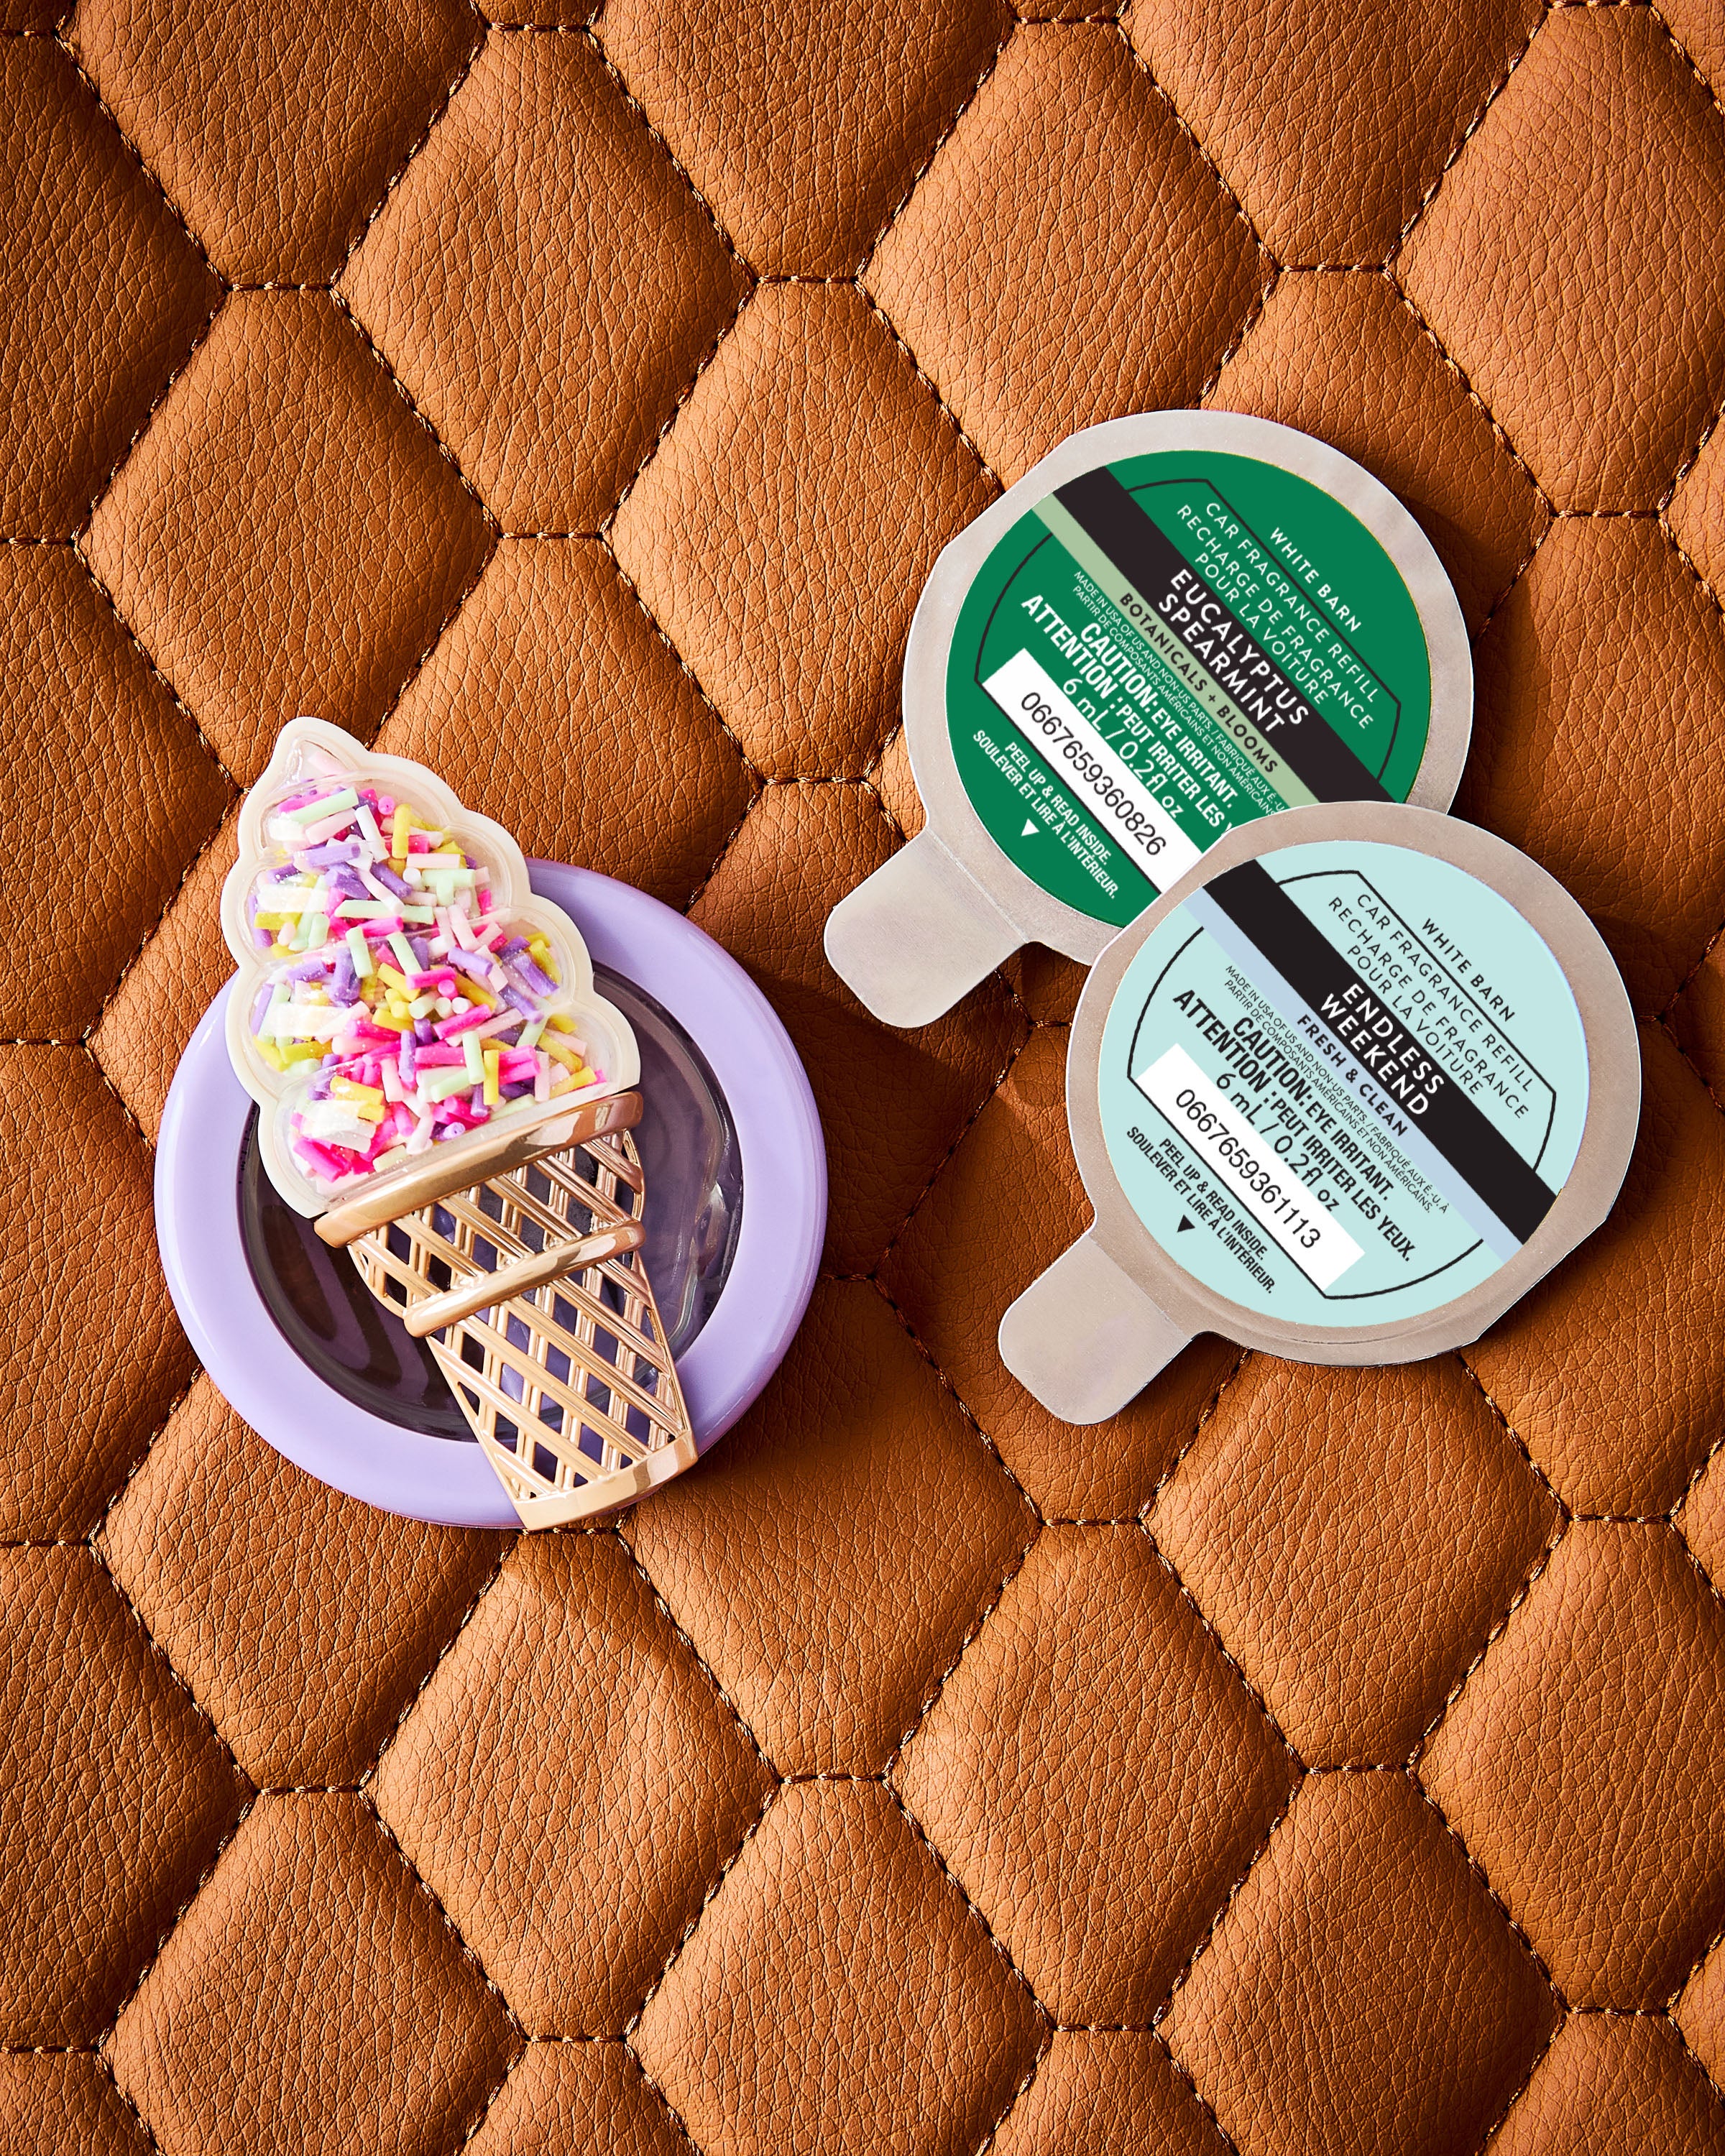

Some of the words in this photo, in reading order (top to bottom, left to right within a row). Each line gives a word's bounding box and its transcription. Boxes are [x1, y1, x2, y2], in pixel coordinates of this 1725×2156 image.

[1170, 568, 1309, 724] EUCALYPTUS
[1177, 505, 1260, 598] RECHARGE
[1257, 597, 1283, 625] DE
[1281, 625, 1374, 729] FRAGRANCE
[1195, 552, 1240, 603] POUR
[1238, 603, 1260, 629] LA
[1263, 627, 1328, 704] VOITURE
[1206, 502, 1239, 540] CAR
[1237, 538, 1330, 643] FRAGRANCE
[1328, 642, 1378, 703] REFILL
[1270, 527, 1319, 584] WHITE
[1317, 584, 1361, 632] BARN
[1021, 594, 1118, 699] ATTENTION
[1115, 704, 1155, 744] PEUT
[1147, 740, 1201, 801] IRRITER
[1195, 794, 1225, 827] LES
[1072, 585, 1100, 617] PARTIR
[1097, 613, 1112, 630] DE
[1109, 627, 1161, 686] COMPOSANTS
[1156, 685, 1205, 737] AMÉRICAINS
[1201, 733, 1215, 747] ET
[1210, 744, 1232, 768] NON
[1073, 571, 1099, 599] MADE
[1095, 595, 1108, 609] IN
[1105, 605, 1122, 627] USA
[1120, 624, 1135, 637] OF
[1131, 636, 1145, 650] US
[1141, 650, 1161, 670] AND
[1158, 667, 1191, 704] NON-US
[1187, 701, 1213, 732] PARTS.
[1215, 733, 1256, 778] FABRIQUÉ
[1250, 776, 1270, 796] AUX
[1080, 622, 1159, 714] CAUTION:
[1151, 706, 1182, 741] EYE
[1174, 735, 1238, 808] IRRITANT.
[1119, 592, 1208, 692] BOTANICALS
[1216, 704, 1278, 773] BLOOMS
[1158, 593, 1285, 732] SPEARMINT
[972, 729, 1023, 787] SOULEVER
[1018, 782, 1036, 799] ET
[1031, 796, 1057, 826] LIRE
[1051, 821, 1066, 836] À
[1004, 742, 1031, 773] PEEL
[1028, 768, 1046, 785] UP
[1041, 785, 1054, 798] &
[1050, 794, 1080, 826] READ
[1075, 823, 1111, 865] INSIDE.
[1021, 692, 1167, 856] 0667659360826
[1062, 678, 1083, 696] 6
[1076, 697, 1109, 732] mL
[1161, 795, 1184, 819] oz
[1328, 896, 1412, 989] RECHARGE
[1411, 989, 1437, 1016] DE
[1435, 1016, 1529, 1119] FRAGRANCE
[1341, 983, 1445, 1094] ENDLESS
[1347, 944, 1392, 995] POUR
[1392, 995, 1412, 1020] LA
[1416, 1018, 1484, 1095] VOITURE
[1357, 894, 1390, 931] CAR
[1389, 930, 1483, 1033] FRAGRANCE
[1481, 1033, 1532, 1092] REFILL
[1422, 918, 1472, 974] WHITE
[1470, 974, 1515, 1022] BARN
[1172, 990, 1272, 1094] ATTENTION
[1269, 1097, 1310, 1138] PEUT
[1302, 1134, 1357, 1194] IRRITER
[1350, 1188, 1381, 1220] LES
[1376, 1215, 1415, 1262] YEUX.
[1224, 979, 1253, 1010] PARTIR
[1250, 1008, 1265, 1023] DE
[1261, 1021, 1315, 1079] COMPOSANTS
[1310, 1078, 1360, 1130] AMÉRICAINS
[1356, 1126, 1370, 1139] ET
[1365, 1137, 1388, 1161] NON
[1384, 1159, 1432, 1213] AMÉRICAINS.
[1225, 965, 1251, 992] MADE
[1248, 989, 1260, 1003] IN
[1257, 1000, 1274, 1021] USA
[1273, 1018, 1287, 1031] OF
[1284, 1029, 1297, 1044] US
[1293, 1043, 1314, 1063] AND
[1311, 1060, 1345, 1097] NON-US
[1341, 1095, 1367, 1124] PARTS.
[1370, 1126, 1411, 1172] FABRIQUÉ
[1406, 1169, 1426, 1188] AUX
[1422, 1184, 1441, 1207] É.-U.
[1438, 1203, 1450, 1214] À
[1233, 1017, 1312, 1107] CAUTION:
[1305, 1100, 1338, 1134] EYE
[1330, 1128, 1394, 1201] IRRITANT.
[1297, 1014, 1347, 1068] FRESH
[1345, 1068, 1358, 1084] &
[1359, 1083, 1408, 1137] CLEAN
[1320, 992, 1428, 1115] WEEKEND
[1126, 1126, 1178, 1182] SOULEVER
[1173, 1178, 1192, 1195] ET
[1186, 1193, 1213, 1221] LIRE
[1207, 1216, 1222, 1231] À
[1159, 1138, 1185, 1169] PEEL
[1182, 1164, 1201, 1180] UP
[1196, 1181, 1208, 1194] &
[1205, 1189, 1236, 1222] READ
[1230, 1219, 1268, 1261] INSIDE.
[1176, 1089, 1321, 1248] 0667659361113
[1216, 1073, 1236, 1089] 6
[1230, 1092, 1263, 1126] mL
[1317, 1189, 1340, 1212] oz
